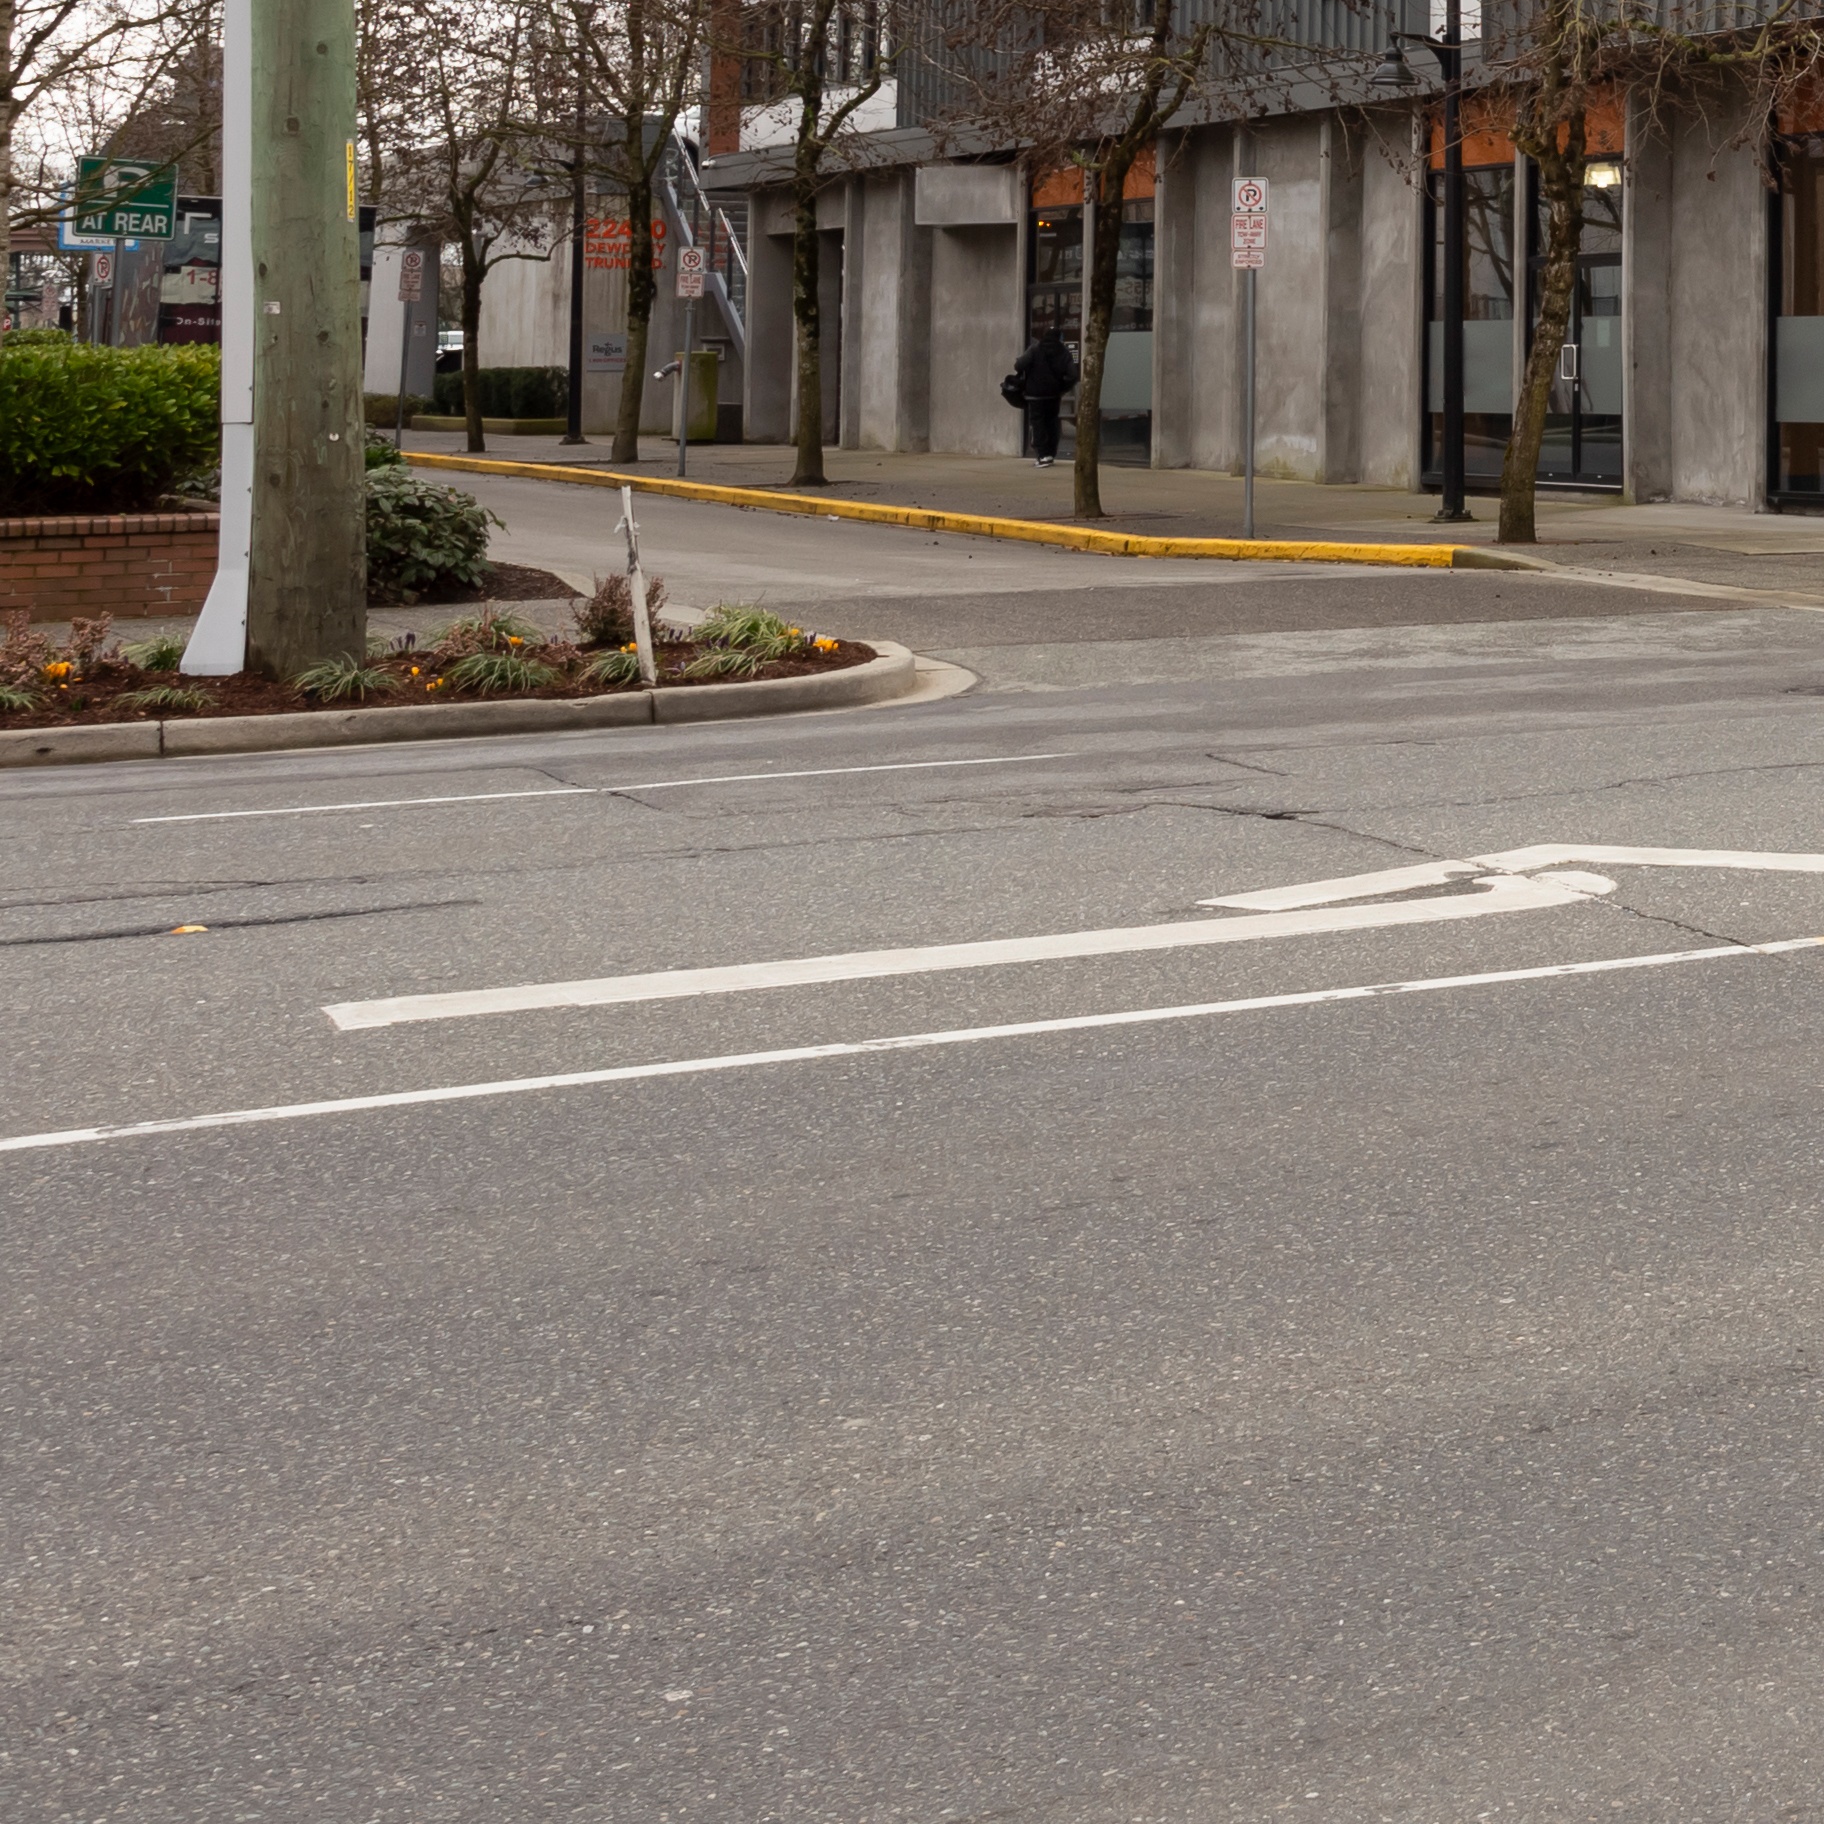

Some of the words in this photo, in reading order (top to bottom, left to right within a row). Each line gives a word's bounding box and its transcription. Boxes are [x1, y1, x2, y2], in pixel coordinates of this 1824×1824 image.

[81, 212, 108, 230] AT
[114, 212, 168, 234] REAR
[585, 217, 668, 240] 2240
[1235, 219, 1248, 229] FIRE
[1249, 219, 1264, 229] LANE
[592, 343, 623, 357] Regus
